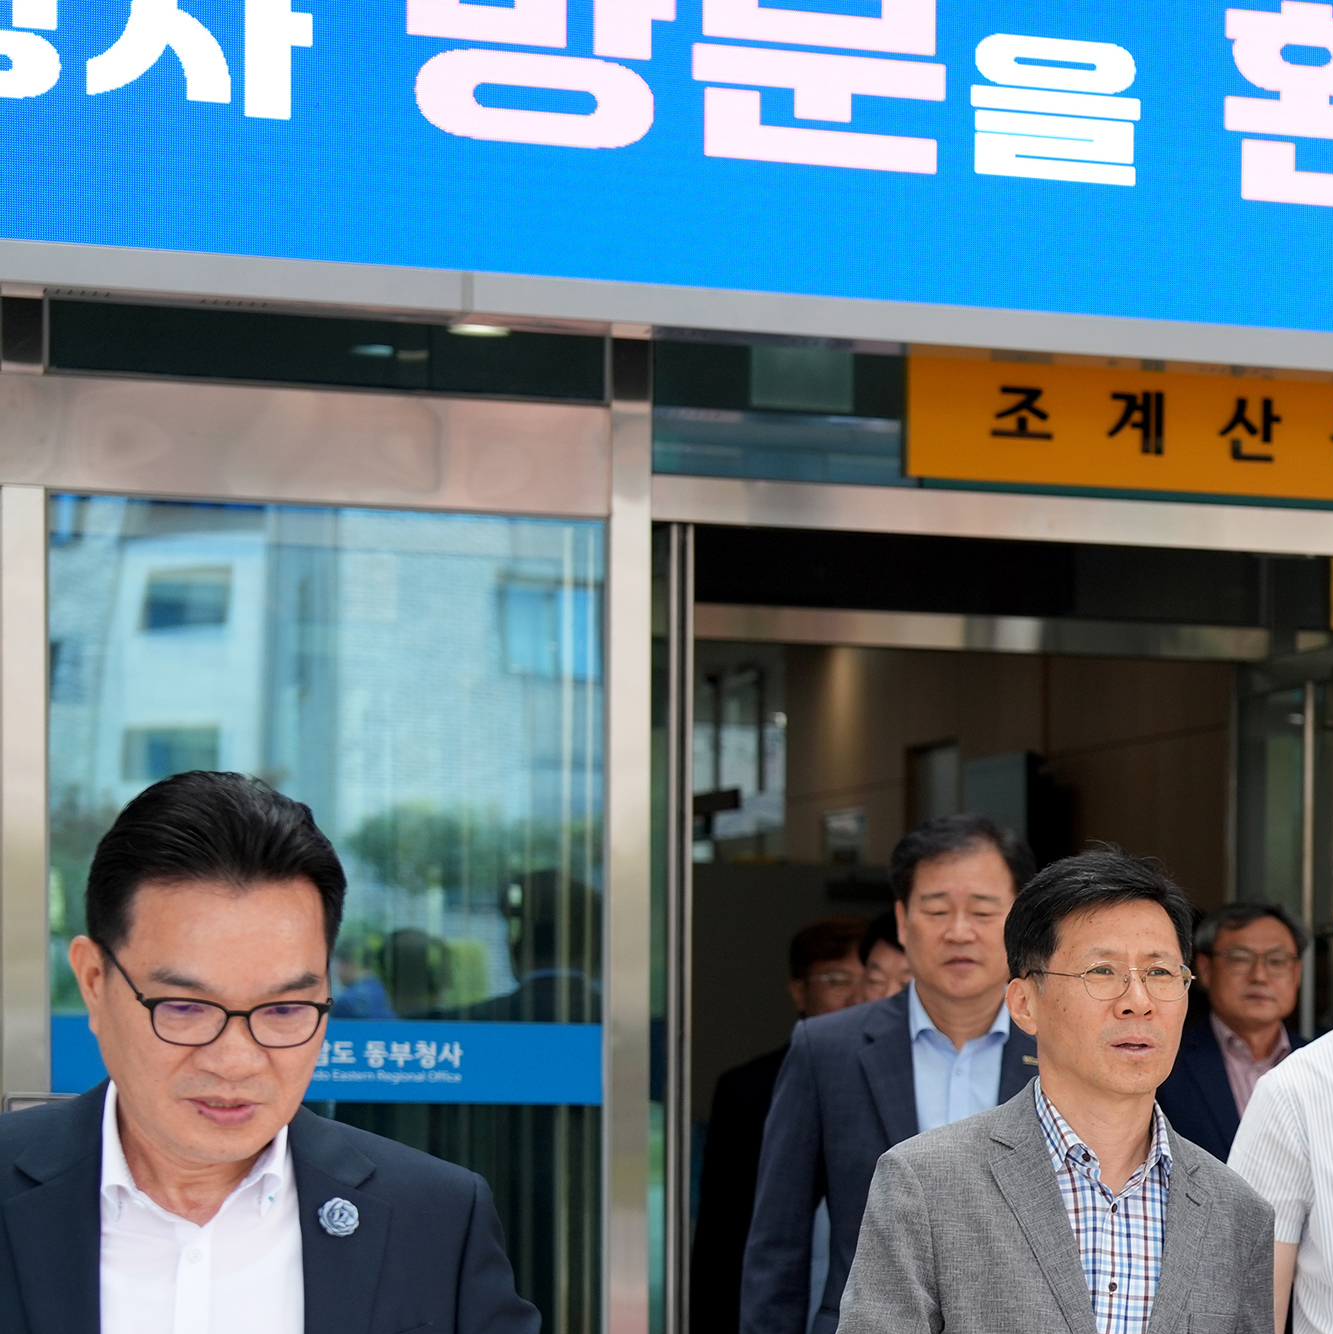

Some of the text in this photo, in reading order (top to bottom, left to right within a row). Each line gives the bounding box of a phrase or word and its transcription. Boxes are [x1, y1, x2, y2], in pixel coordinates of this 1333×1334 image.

[406, 0, 1141, 186] 방문을
[364, 1040, 464, 1069] 동부청사
[377, 1069, 425, 1085] Regional
[427, 1069, 463, 1083] Office
